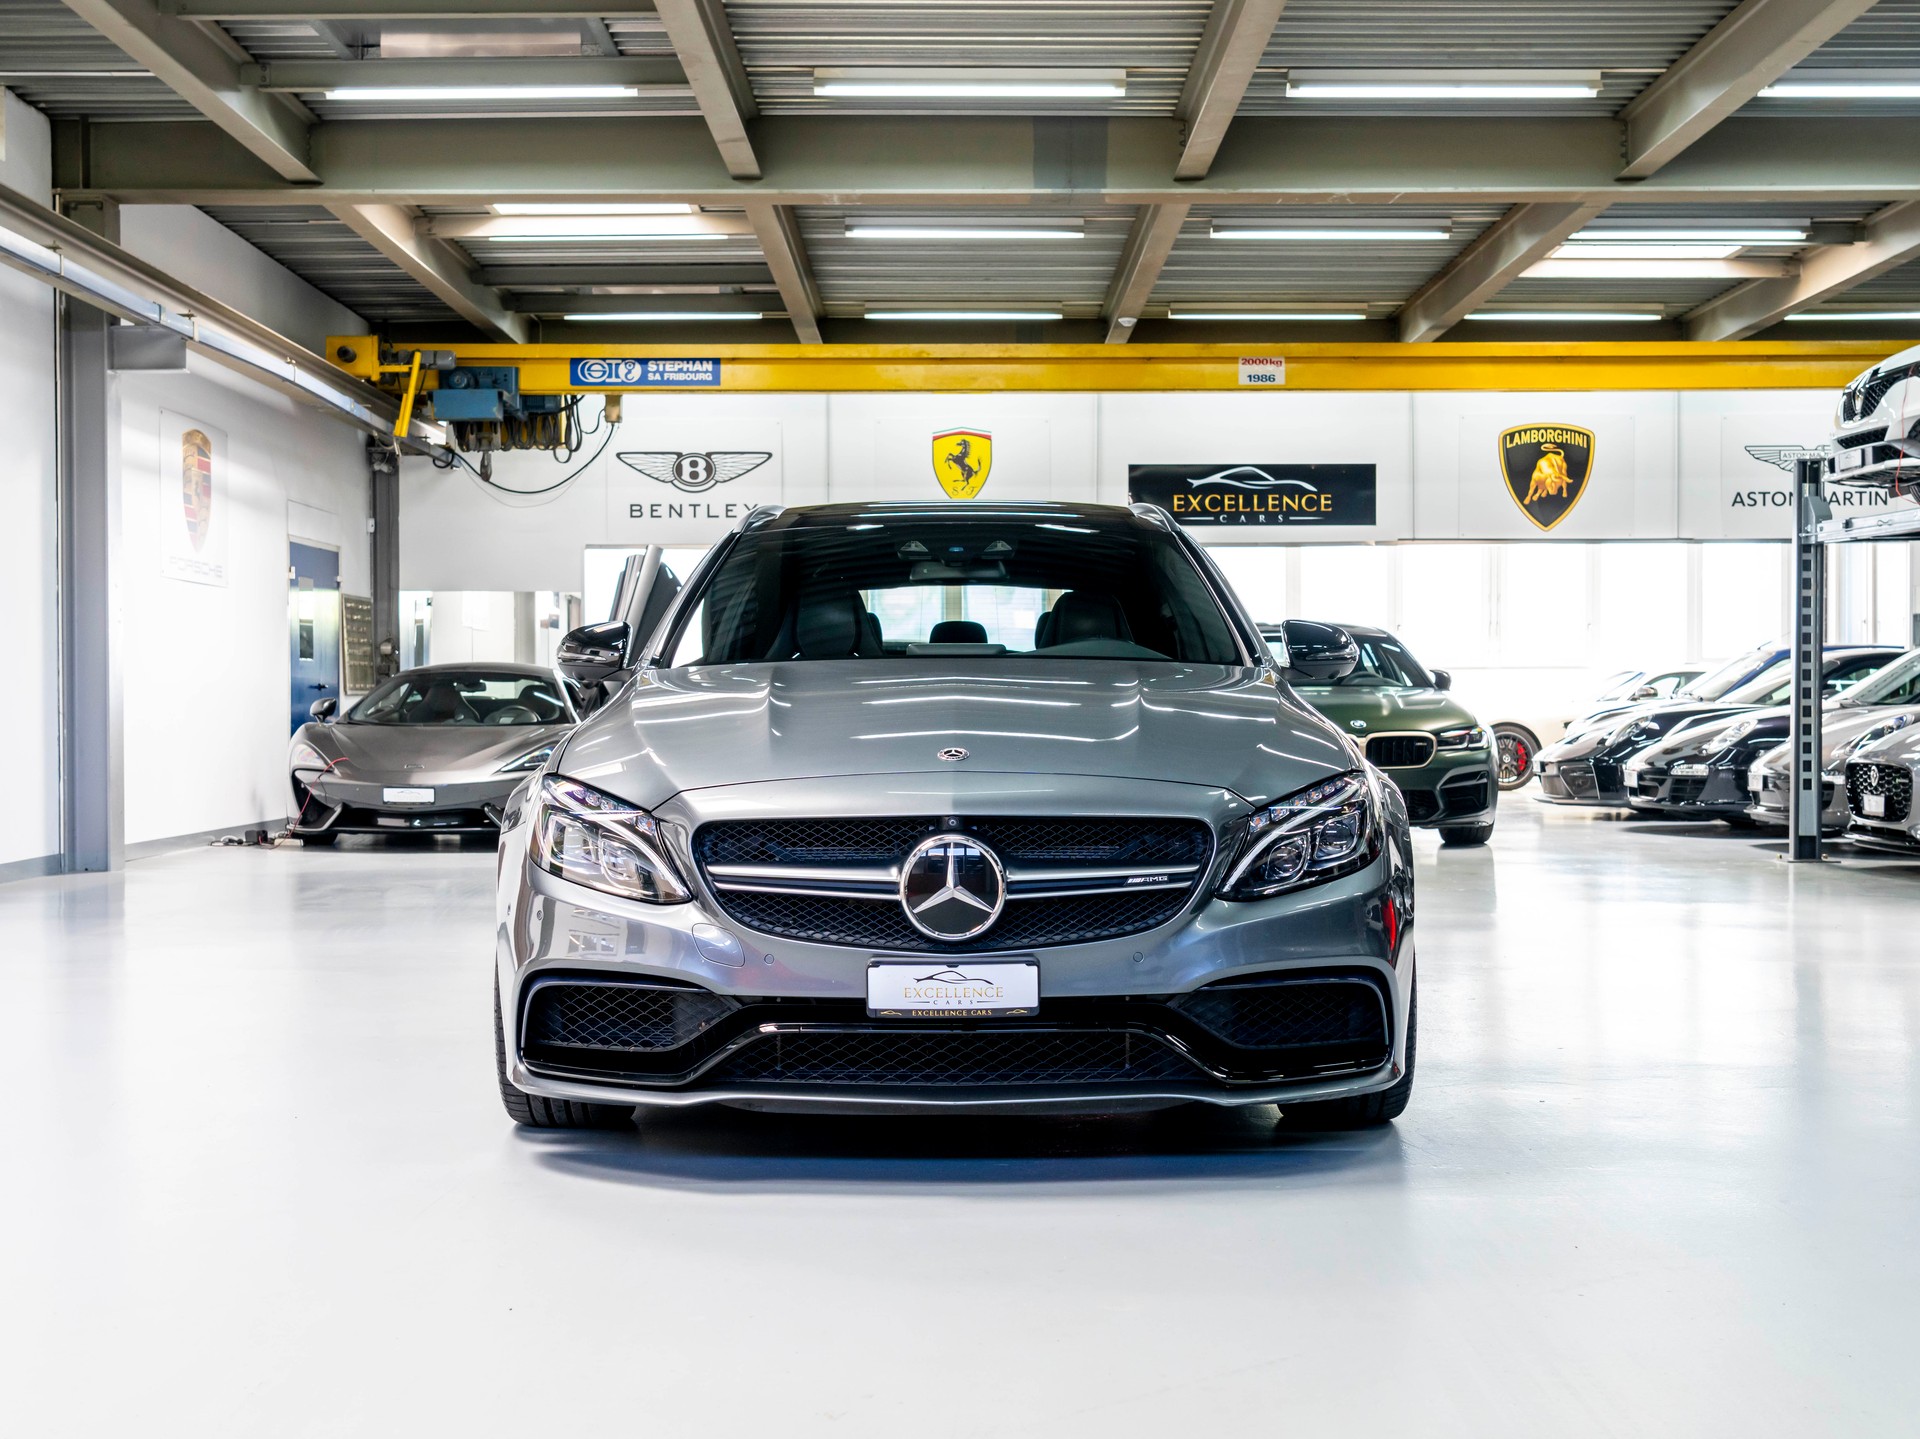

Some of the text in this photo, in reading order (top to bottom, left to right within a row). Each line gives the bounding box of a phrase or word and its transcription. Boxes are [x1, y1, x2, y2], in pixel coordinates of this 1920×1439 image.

[647, 360, 713, 372] STEPHAN
[647, 373, 713, 381] SA FRIBOURG
[1247, 373, 1276, 383] 1986
[1506, 429, 1588, 449] LAMBORGHINI
[1173, 494, 1333, 512] EXCELLENCE
[1827, 491, 1888, 506] ARTIN
[1219, 514, 1284, 523] CARS
[904, 986, 1004, 999] EXCELLENCE
[912, 1009, 968, 1017] EXCELLENCE
